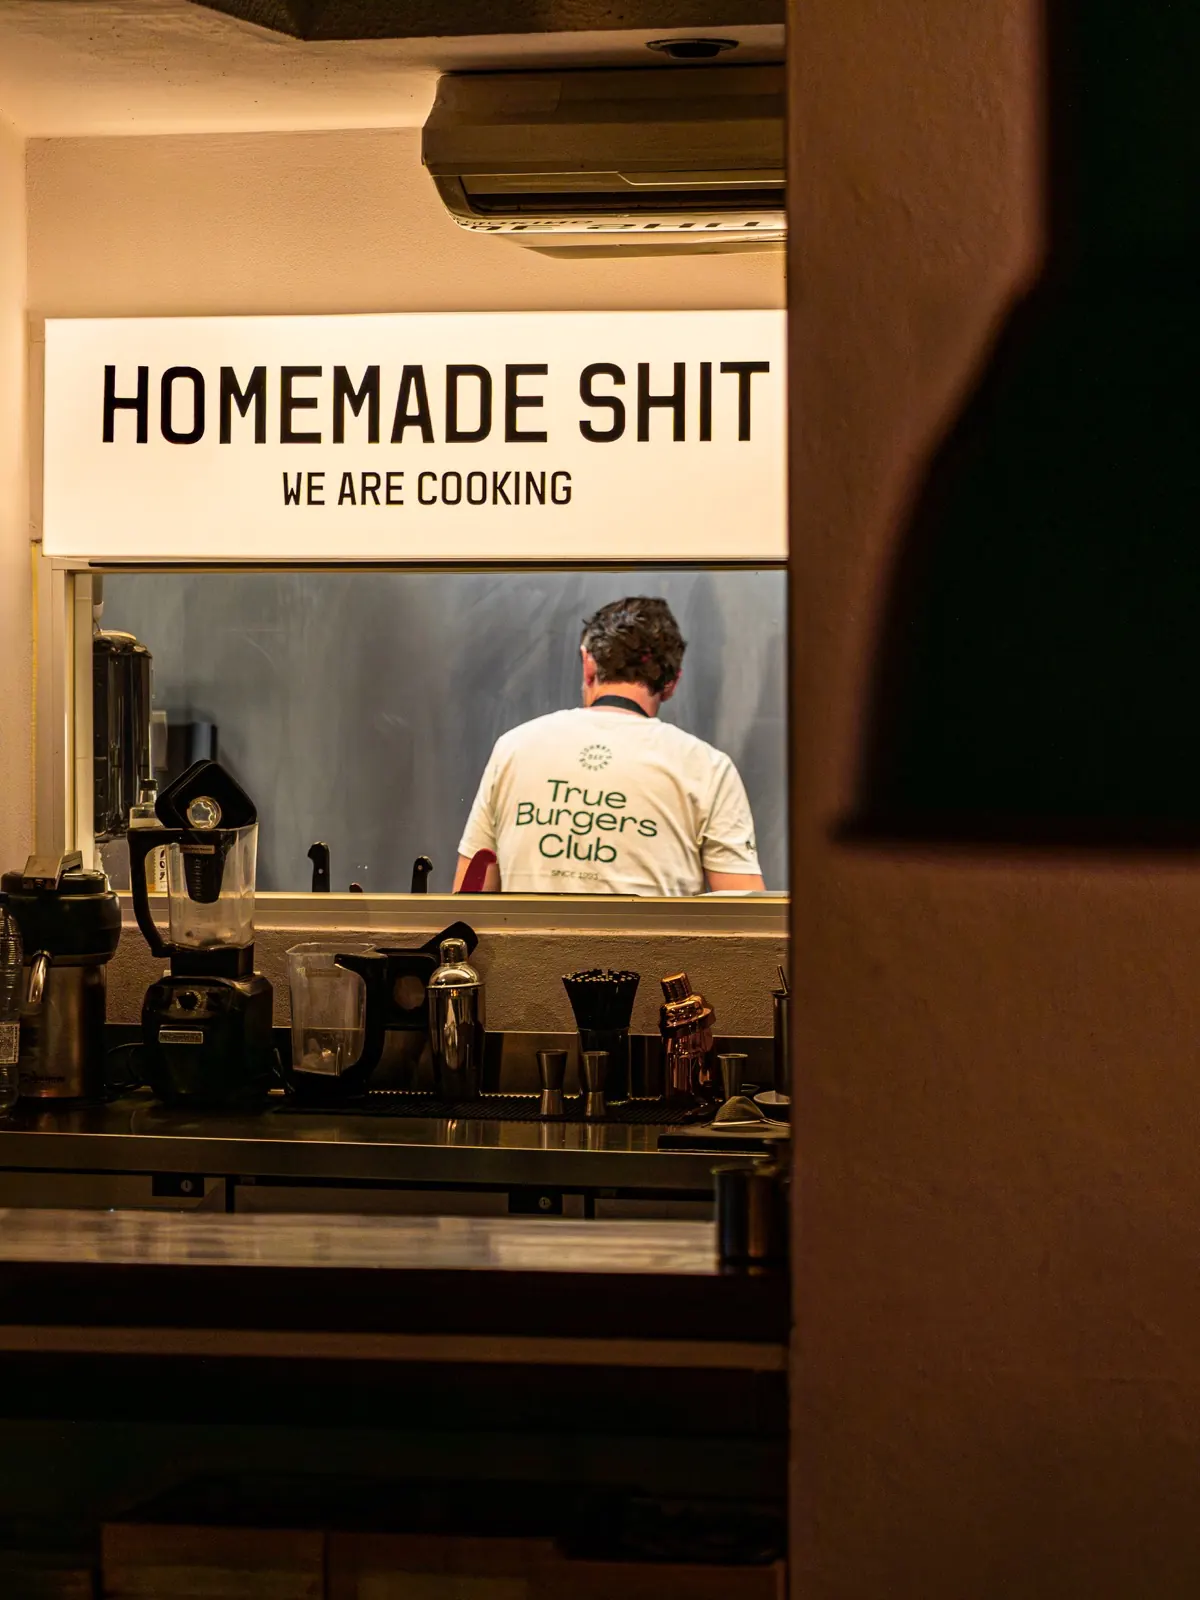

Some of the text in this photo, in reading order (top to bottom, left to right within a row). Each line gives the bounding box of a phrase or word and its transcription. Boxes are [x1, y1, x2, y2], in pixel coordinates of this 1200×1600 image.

[102, 361, 770, 445] HOMEMADE SHIT
[282, 470, 572, 506] WE ARE COOKING
[547, 778, 627, 810] True
[515, 801, 658, 838] Burgers
[538, 833, 618, 864] Club
